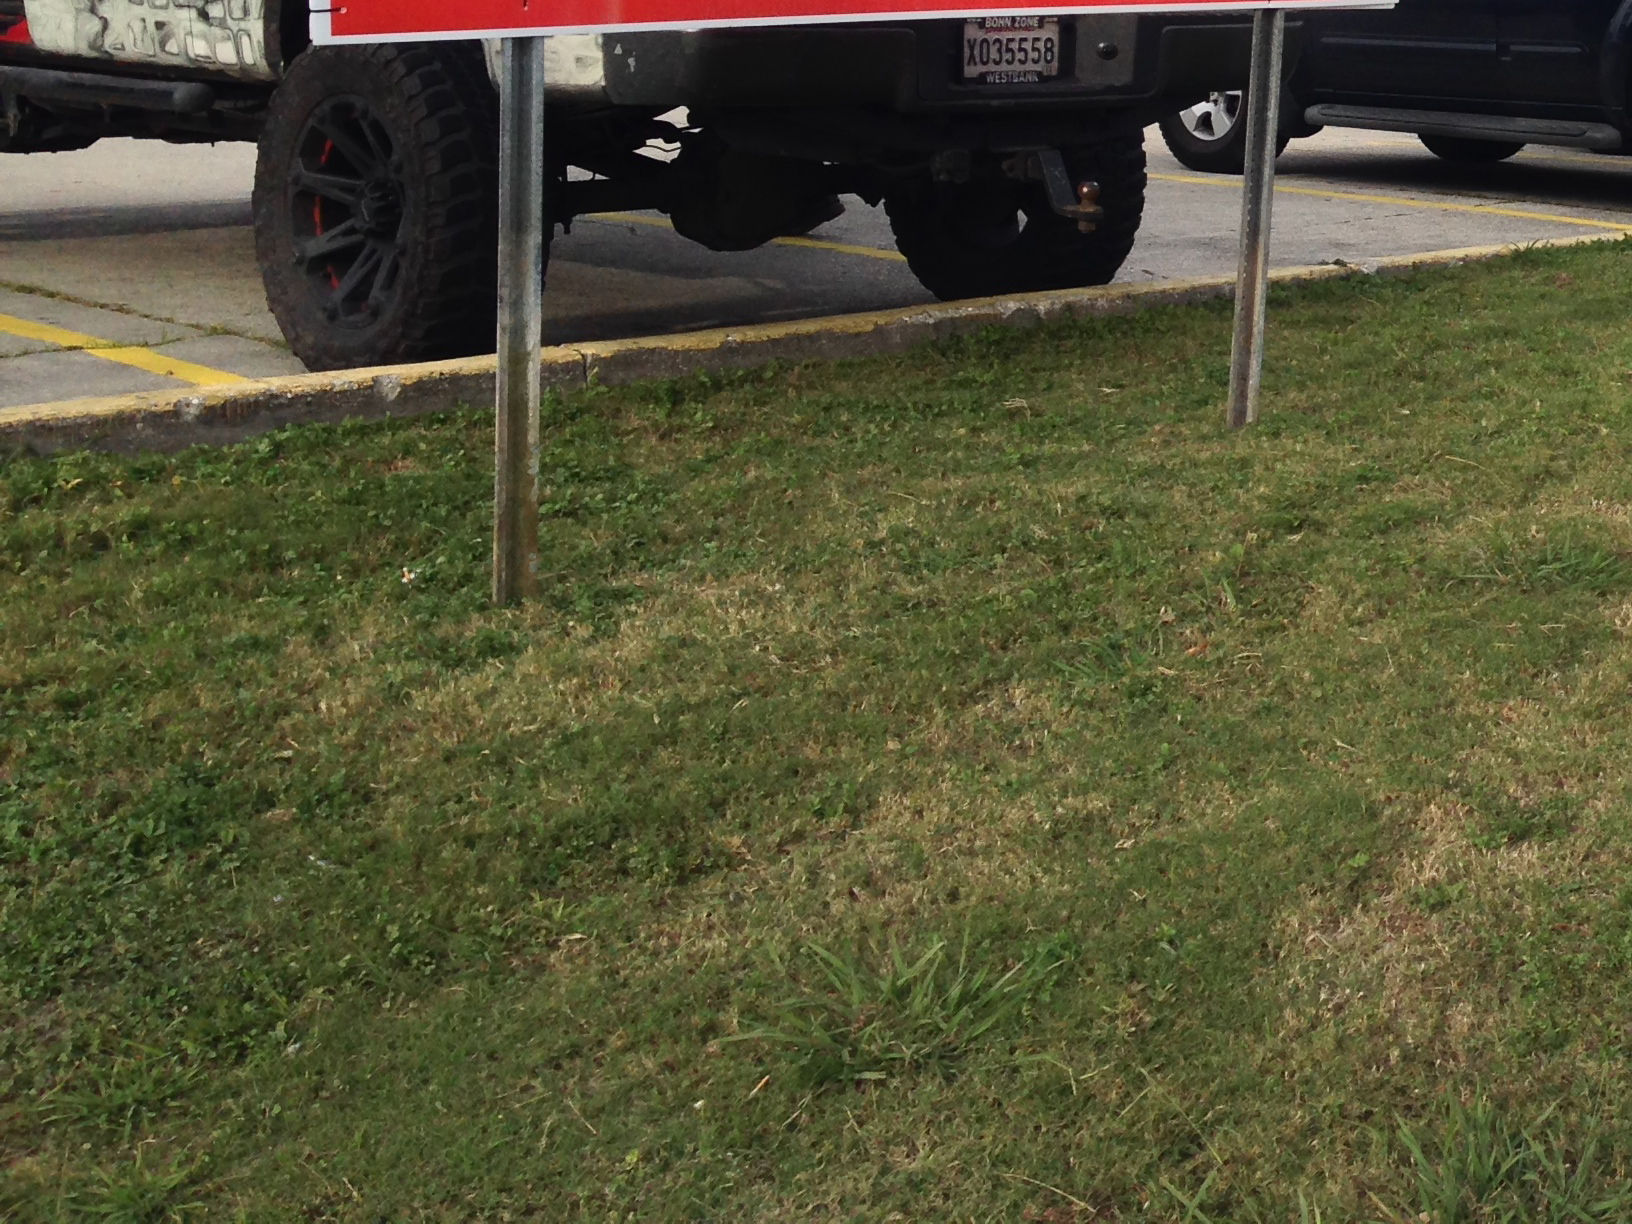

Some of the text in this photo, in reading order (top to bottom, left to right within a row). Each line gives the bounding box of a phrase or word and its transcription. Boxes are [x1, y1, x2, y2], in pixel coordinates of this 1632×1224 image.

[1014, 16, 1039, 27] ZONE
[967, 36, 1055, 67] X035558
[986, 71, 1039, 83] WESTBANK
